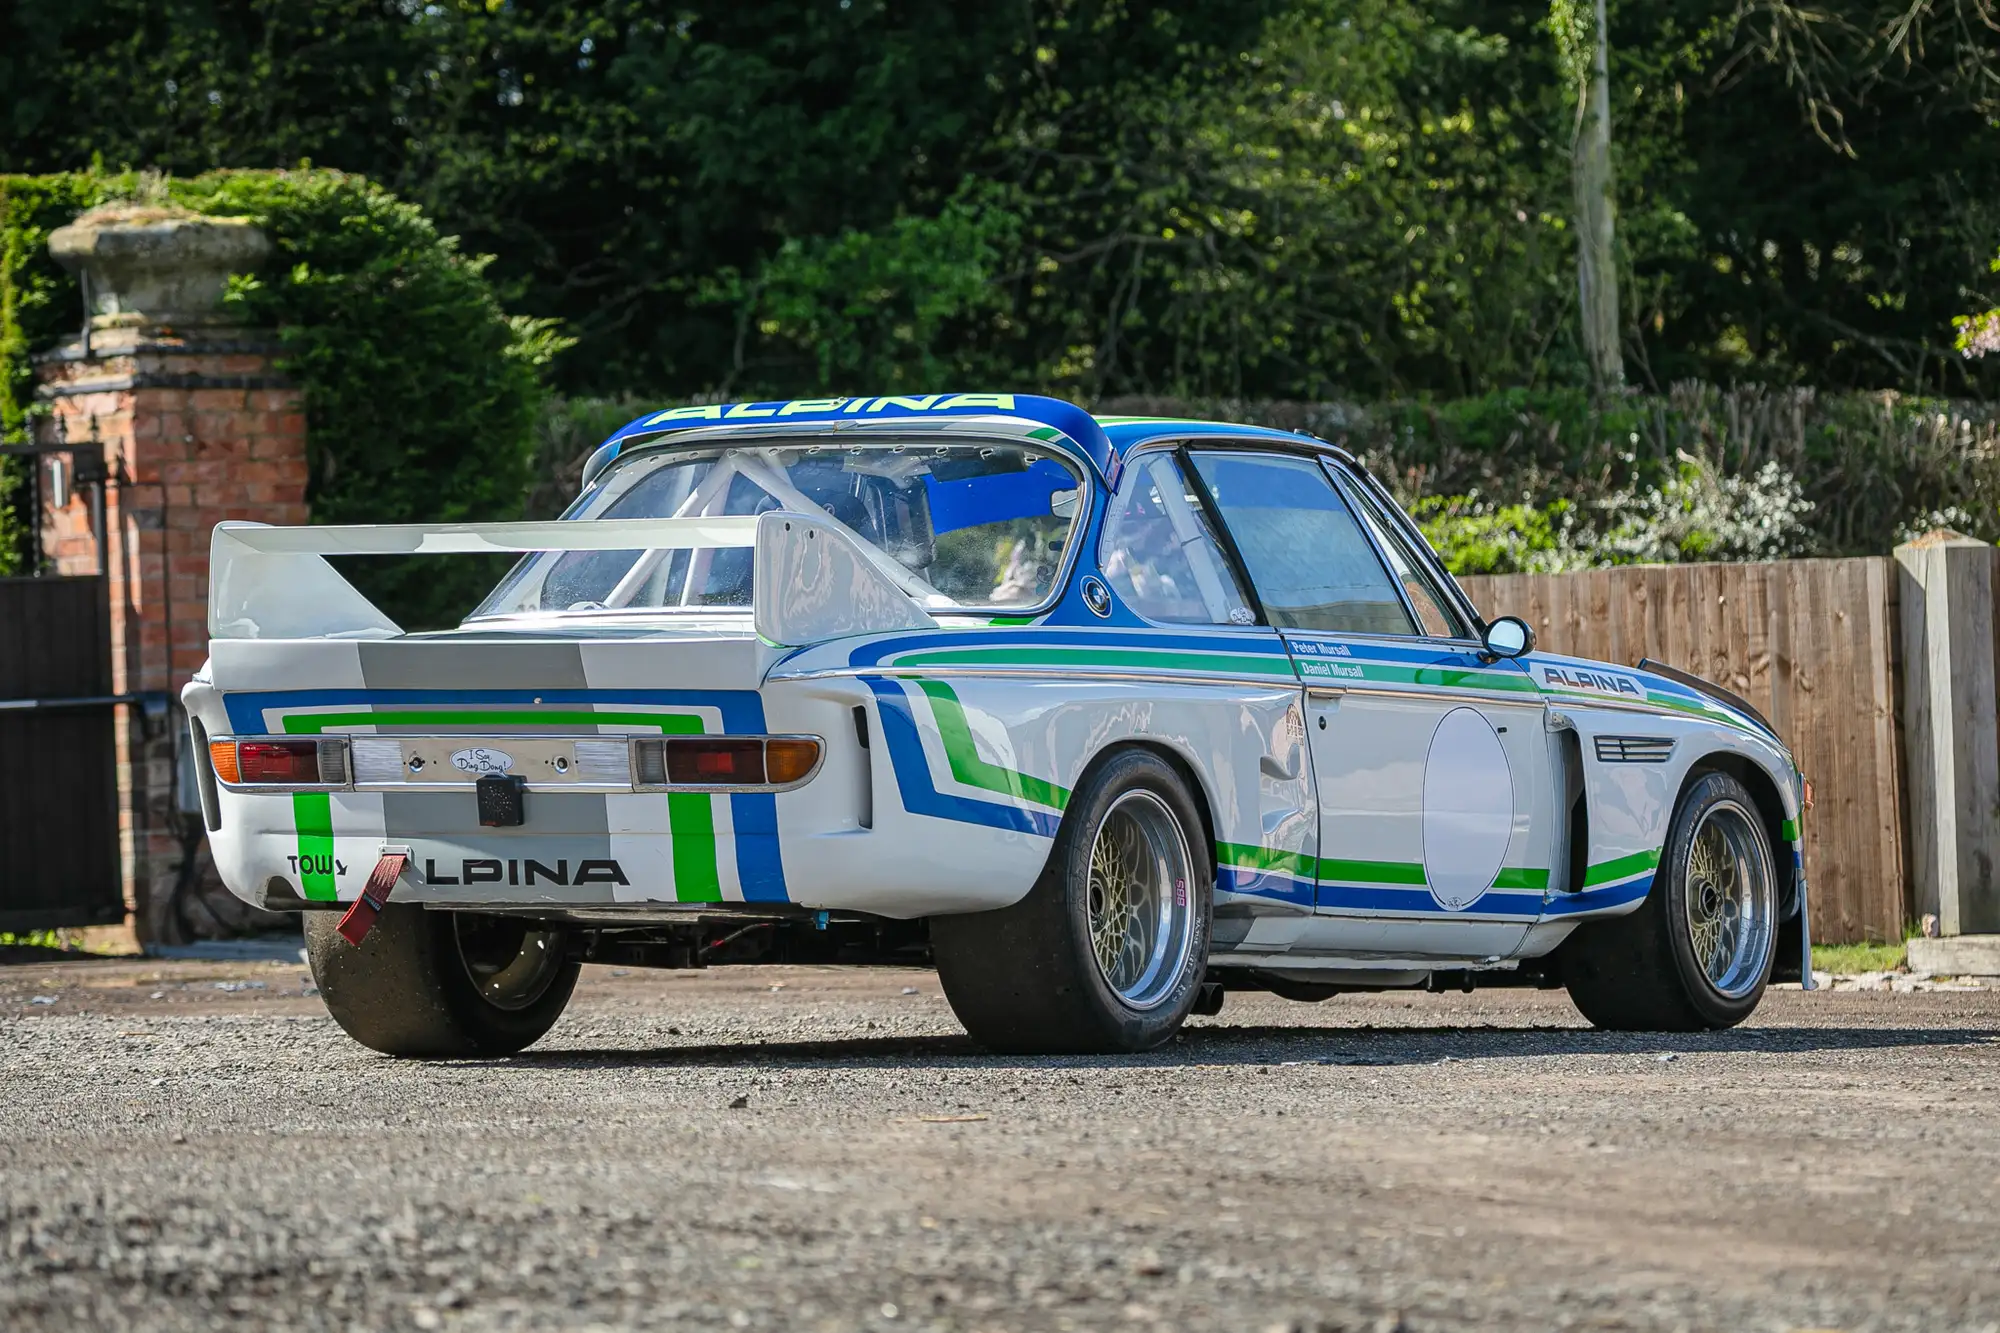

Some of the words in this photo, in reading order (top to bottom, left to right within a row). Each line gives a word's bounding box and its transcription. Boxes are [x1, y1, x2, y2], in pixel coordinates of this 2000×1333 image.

[641, 394, 1015, 427] ALPINA
[1291, 641, 1317, 654] Peter
[1316, 643, 1352, 656] Mursall
[1301, 662, 1331, 675] Daniel
[1331, 664, 1364, 677] Mursall
[1543, 667, 1639, 694] ALPINA
[469, 750, 473, 760] I
[457, 757, 478, 772] Ding
[480, 760, 507, 773] Dong!
[287, 854, 333, 875] TOW
[1176, 880, 1186, 907] BBS
